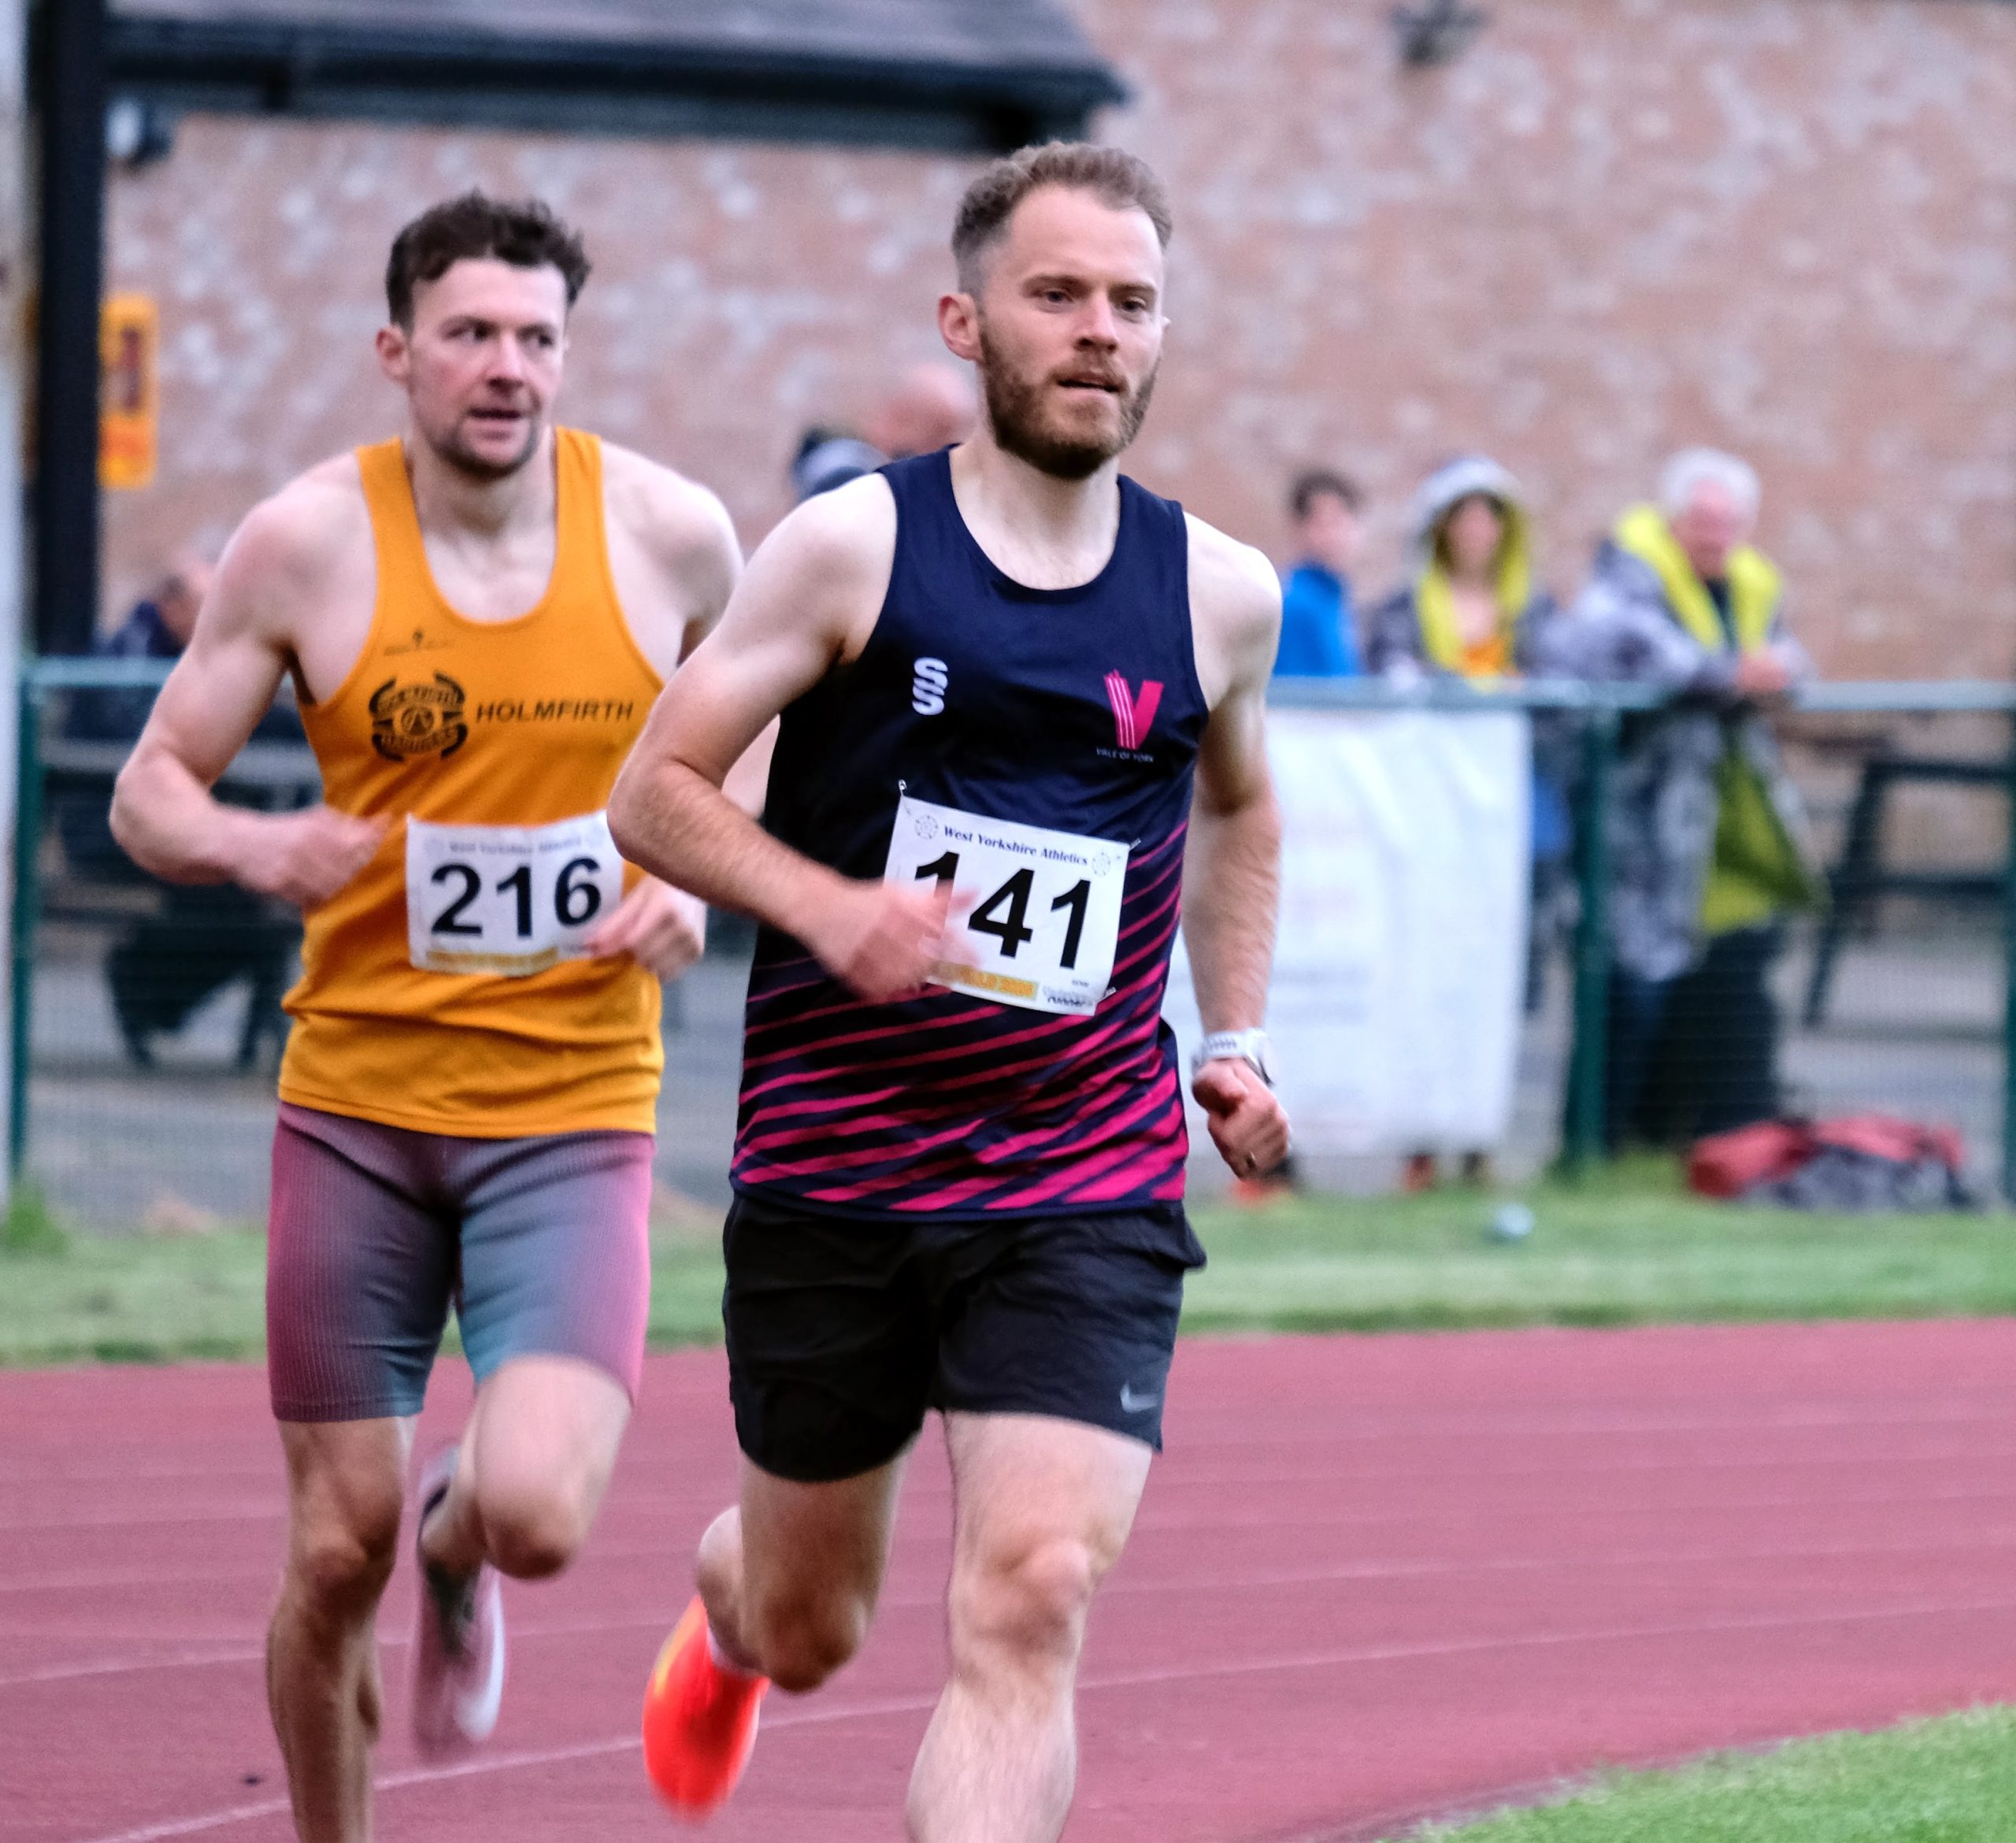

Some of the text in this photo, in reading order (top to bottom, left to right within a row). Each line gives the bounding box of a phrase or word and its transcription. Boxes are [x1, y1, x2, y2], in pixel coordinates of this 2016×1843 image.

[476, 697, 634, 724] HOLMFIRTH
[944, 825, 1088, 866] West Yorkshire Athletics
[431, 856, 601, 939] 216
